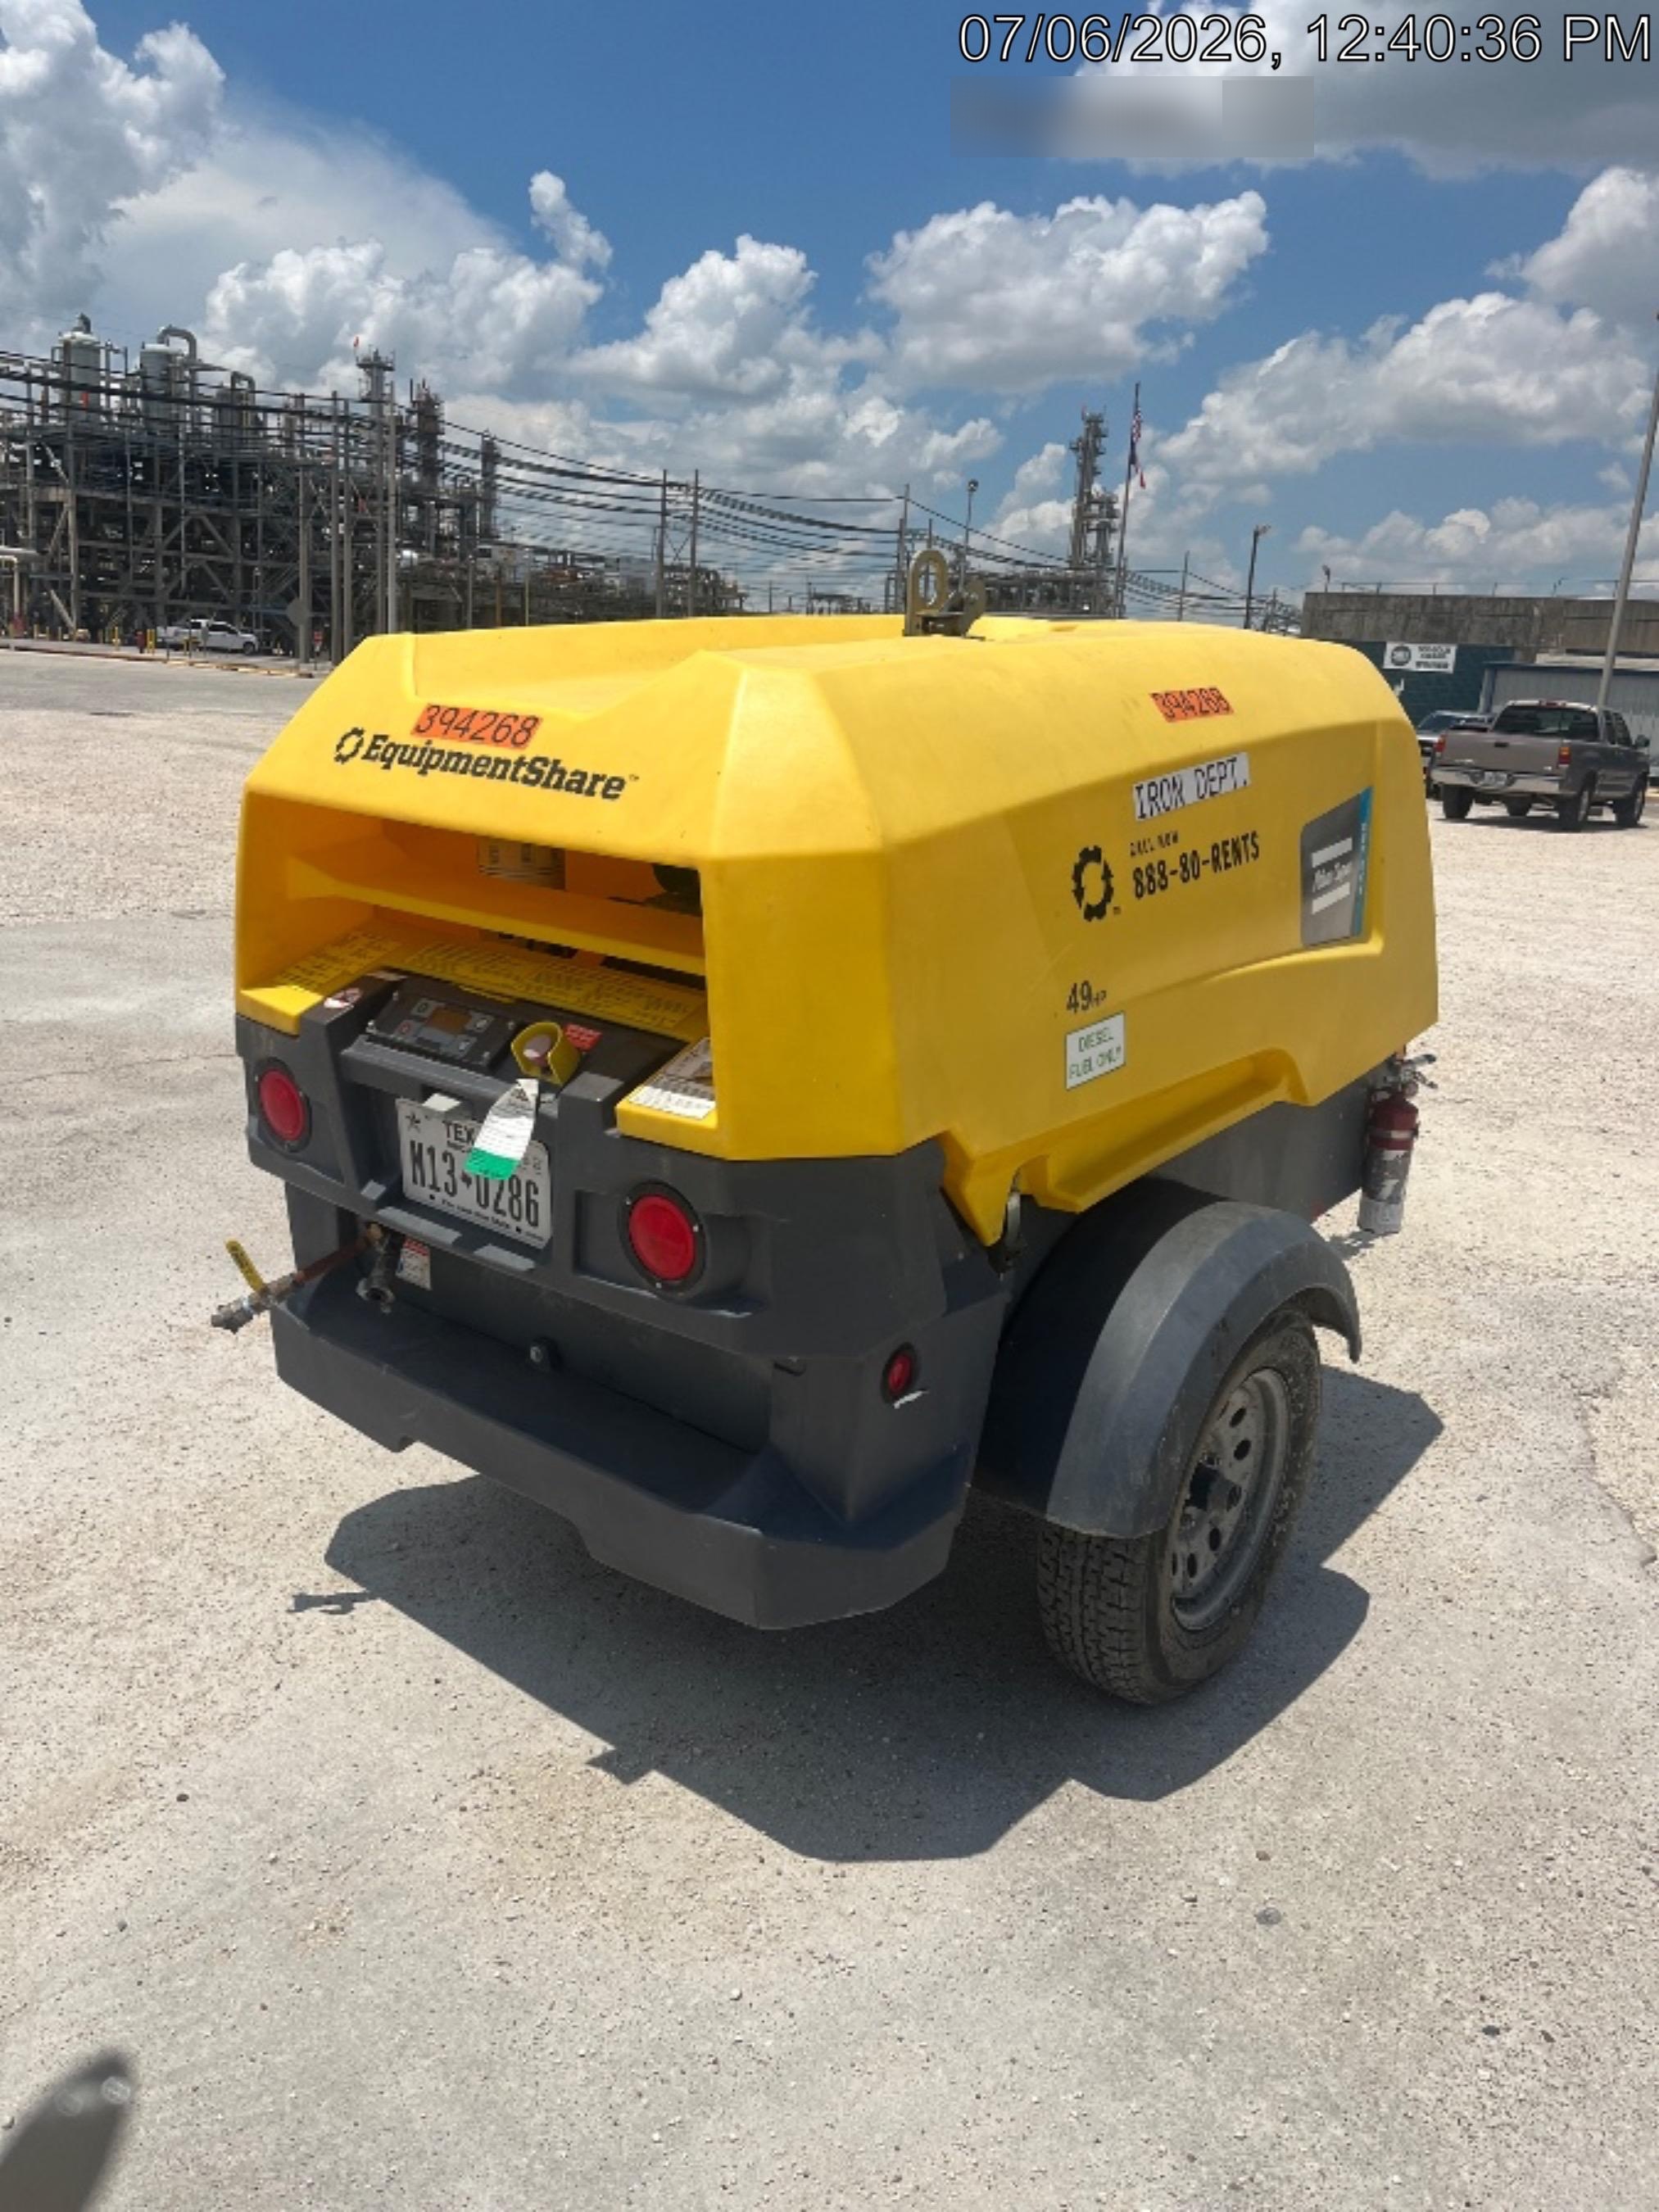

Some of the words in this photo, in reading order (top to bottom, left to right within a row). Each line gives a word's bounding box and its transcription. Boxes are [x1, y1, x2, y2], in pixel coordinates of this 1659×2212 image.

[414, 704, 539, 748] 394268
[1151, 687, 1231, 718] 394268
[360, 734, 628, 800] EquipmentShare
[1135, 776, 1185, 819] IRON
[1194, 756, 1247, 800] DEPT.
[1133, 830, 1260, 900] 888-80-RENTS
